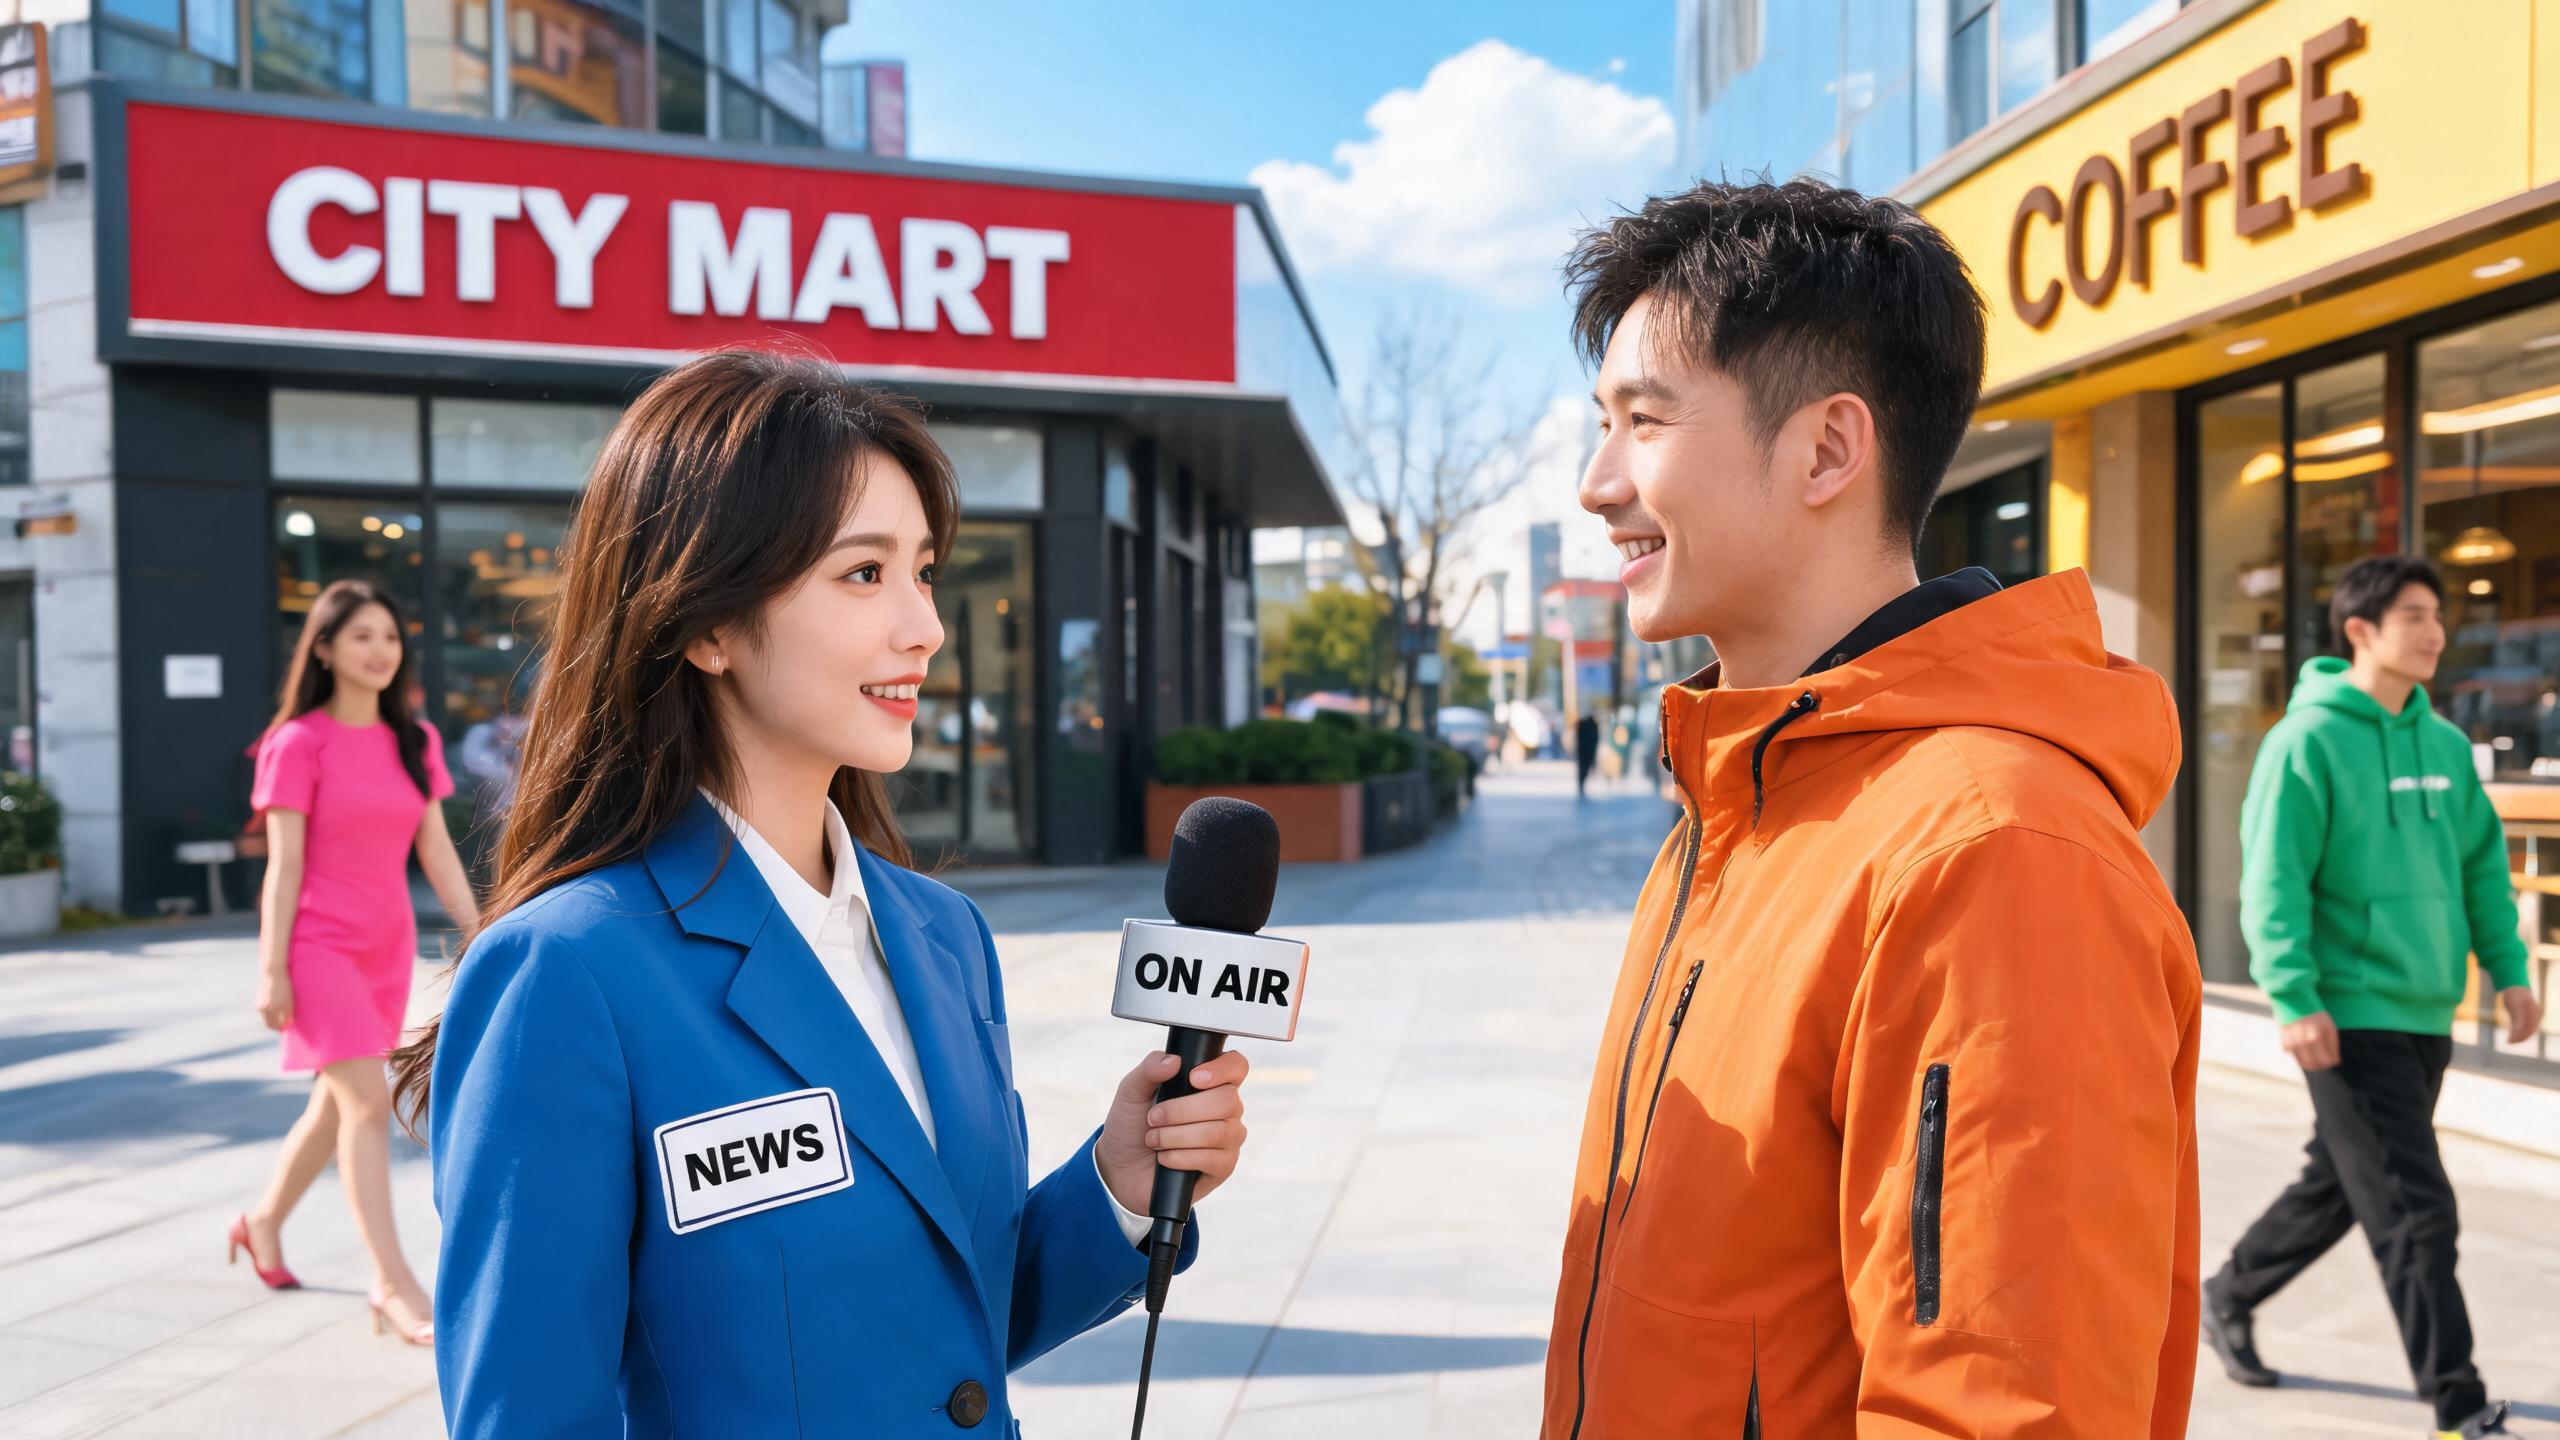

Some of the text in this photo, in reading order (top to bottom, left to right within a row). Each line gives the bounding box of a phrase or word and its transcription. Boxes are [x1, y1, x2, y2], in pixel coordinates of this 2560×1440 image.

[2008, 17, 2370, 330] COFFEE
[267, 166, 1070, 340] CITY MART
[1134, 953, 1290, 1007] ON AIR
[684, 1123, 824, 1192] NEWS
